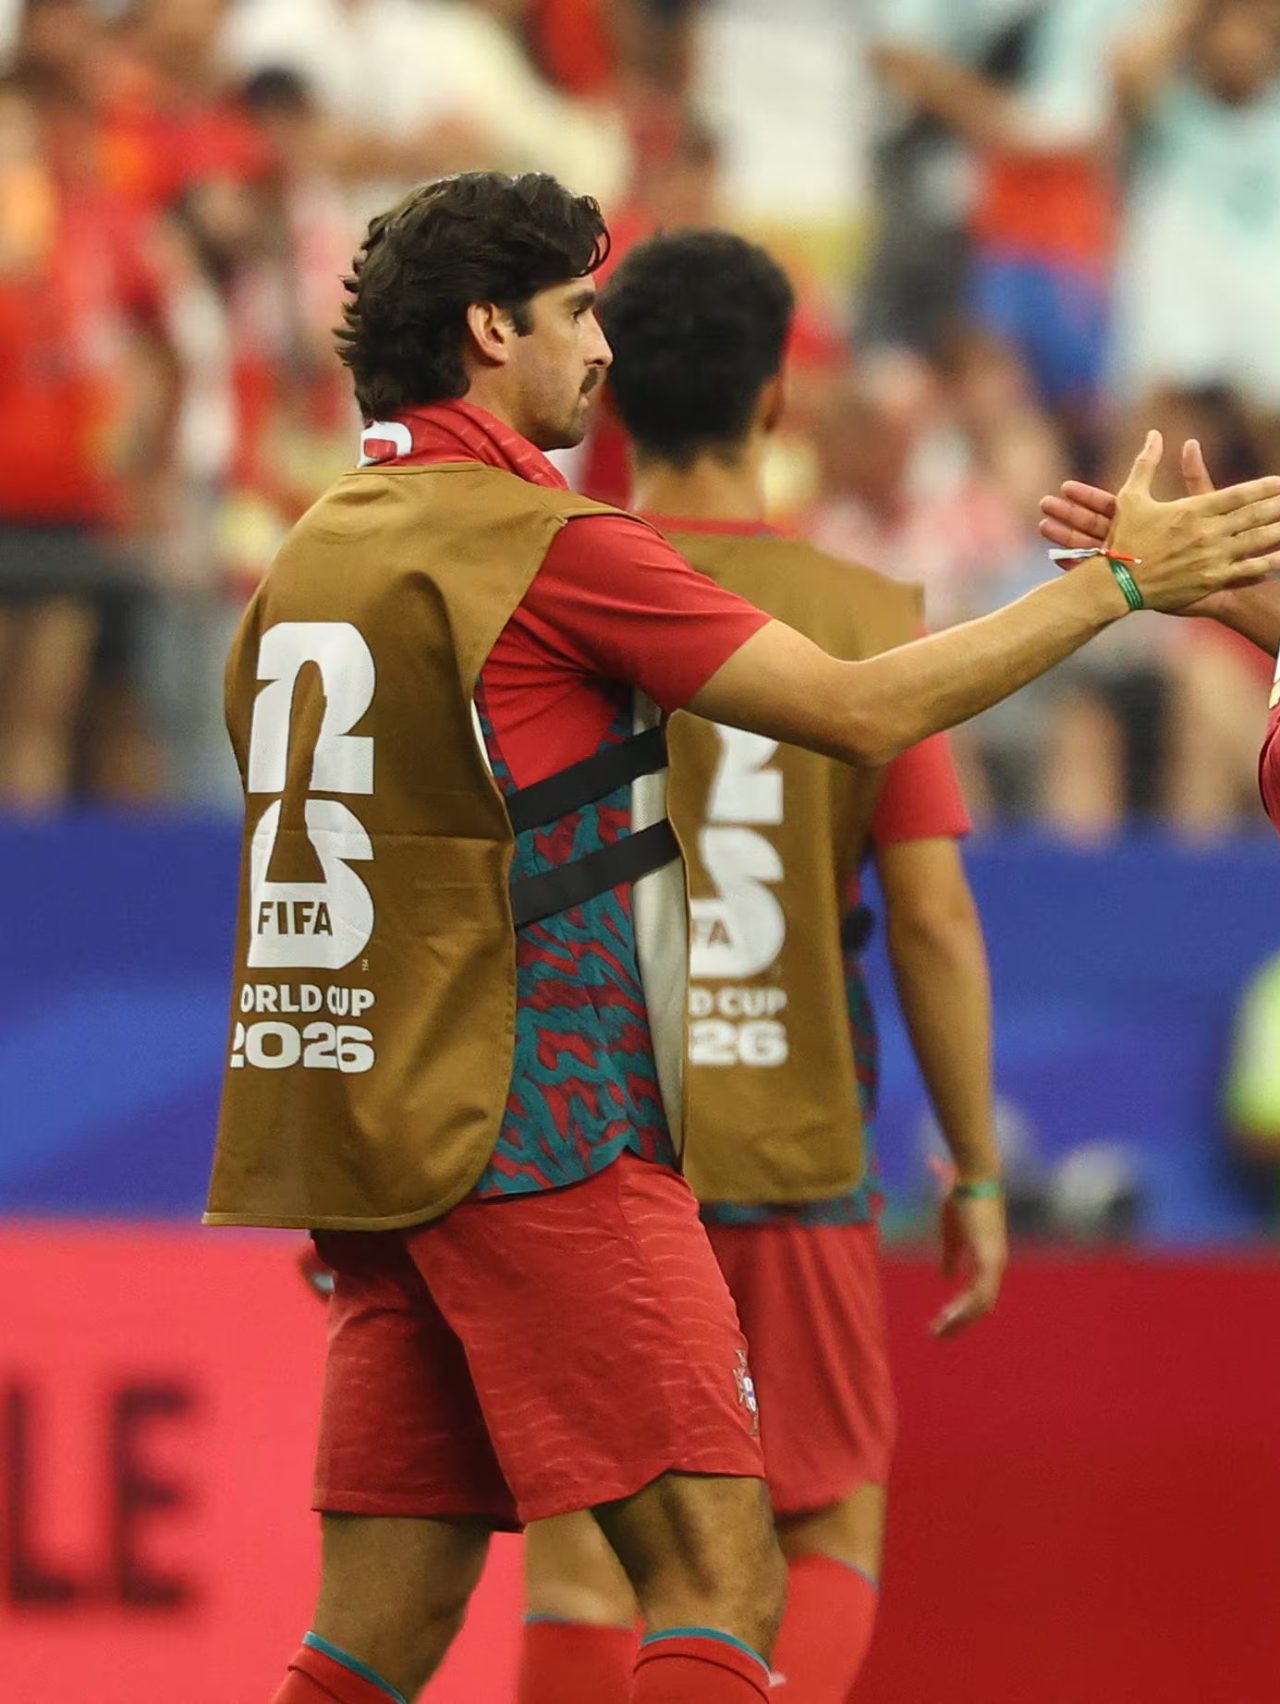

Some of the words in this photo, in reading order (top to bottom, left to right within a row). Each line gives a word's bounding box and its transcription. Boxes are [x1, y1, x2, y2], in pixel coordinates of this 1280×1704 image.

[257, 900, 333, 936] FIFA
[240, 983, 323, 1013] ORLD
[326, 984, 376, 1017] CUP
[717, 985, 788, 1017] CUP
[687, 1018, 789, 1067] 26
